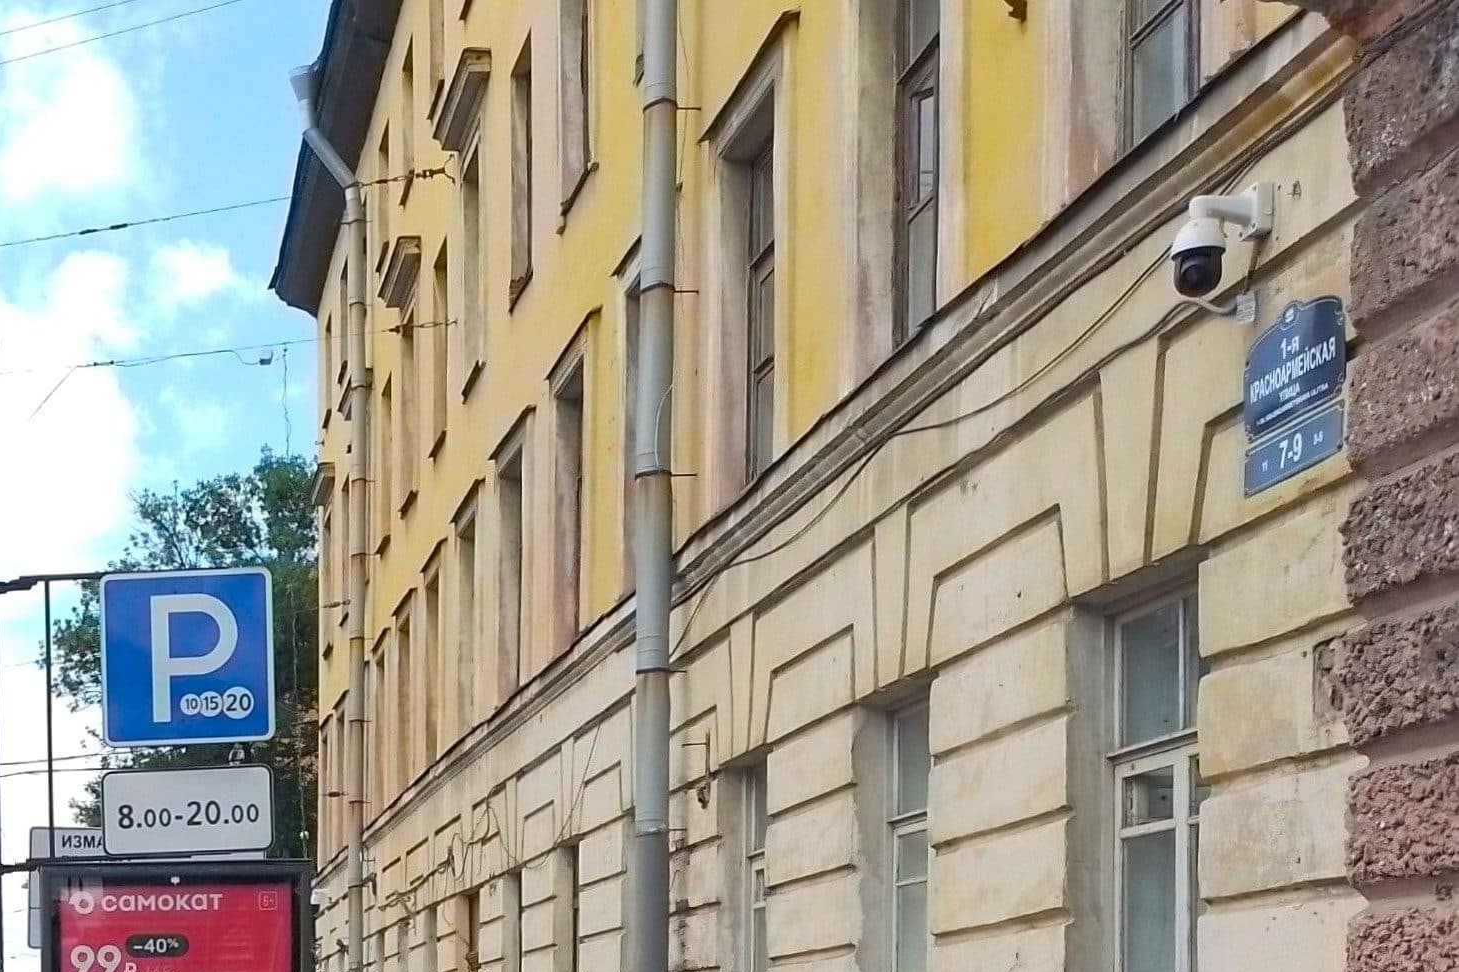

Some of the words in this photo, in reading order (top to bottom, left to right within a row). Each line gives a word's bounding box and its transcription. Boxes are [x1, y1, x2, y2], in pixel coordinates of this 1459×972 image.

[1250, 337, 1336, 404] КРАСНОАРМЕЙСКАЯ
[1279, 433, 1303, 468] 7-9
[150, 593, 239, 723] P
[185, 698, 198, 710] 10
[203, 696, 219, 711] 15
[226, 693, 251, 712] 20
[118, 800, 259, 829] 8.00-20.00
[101, 893, 224, 912] самокат
